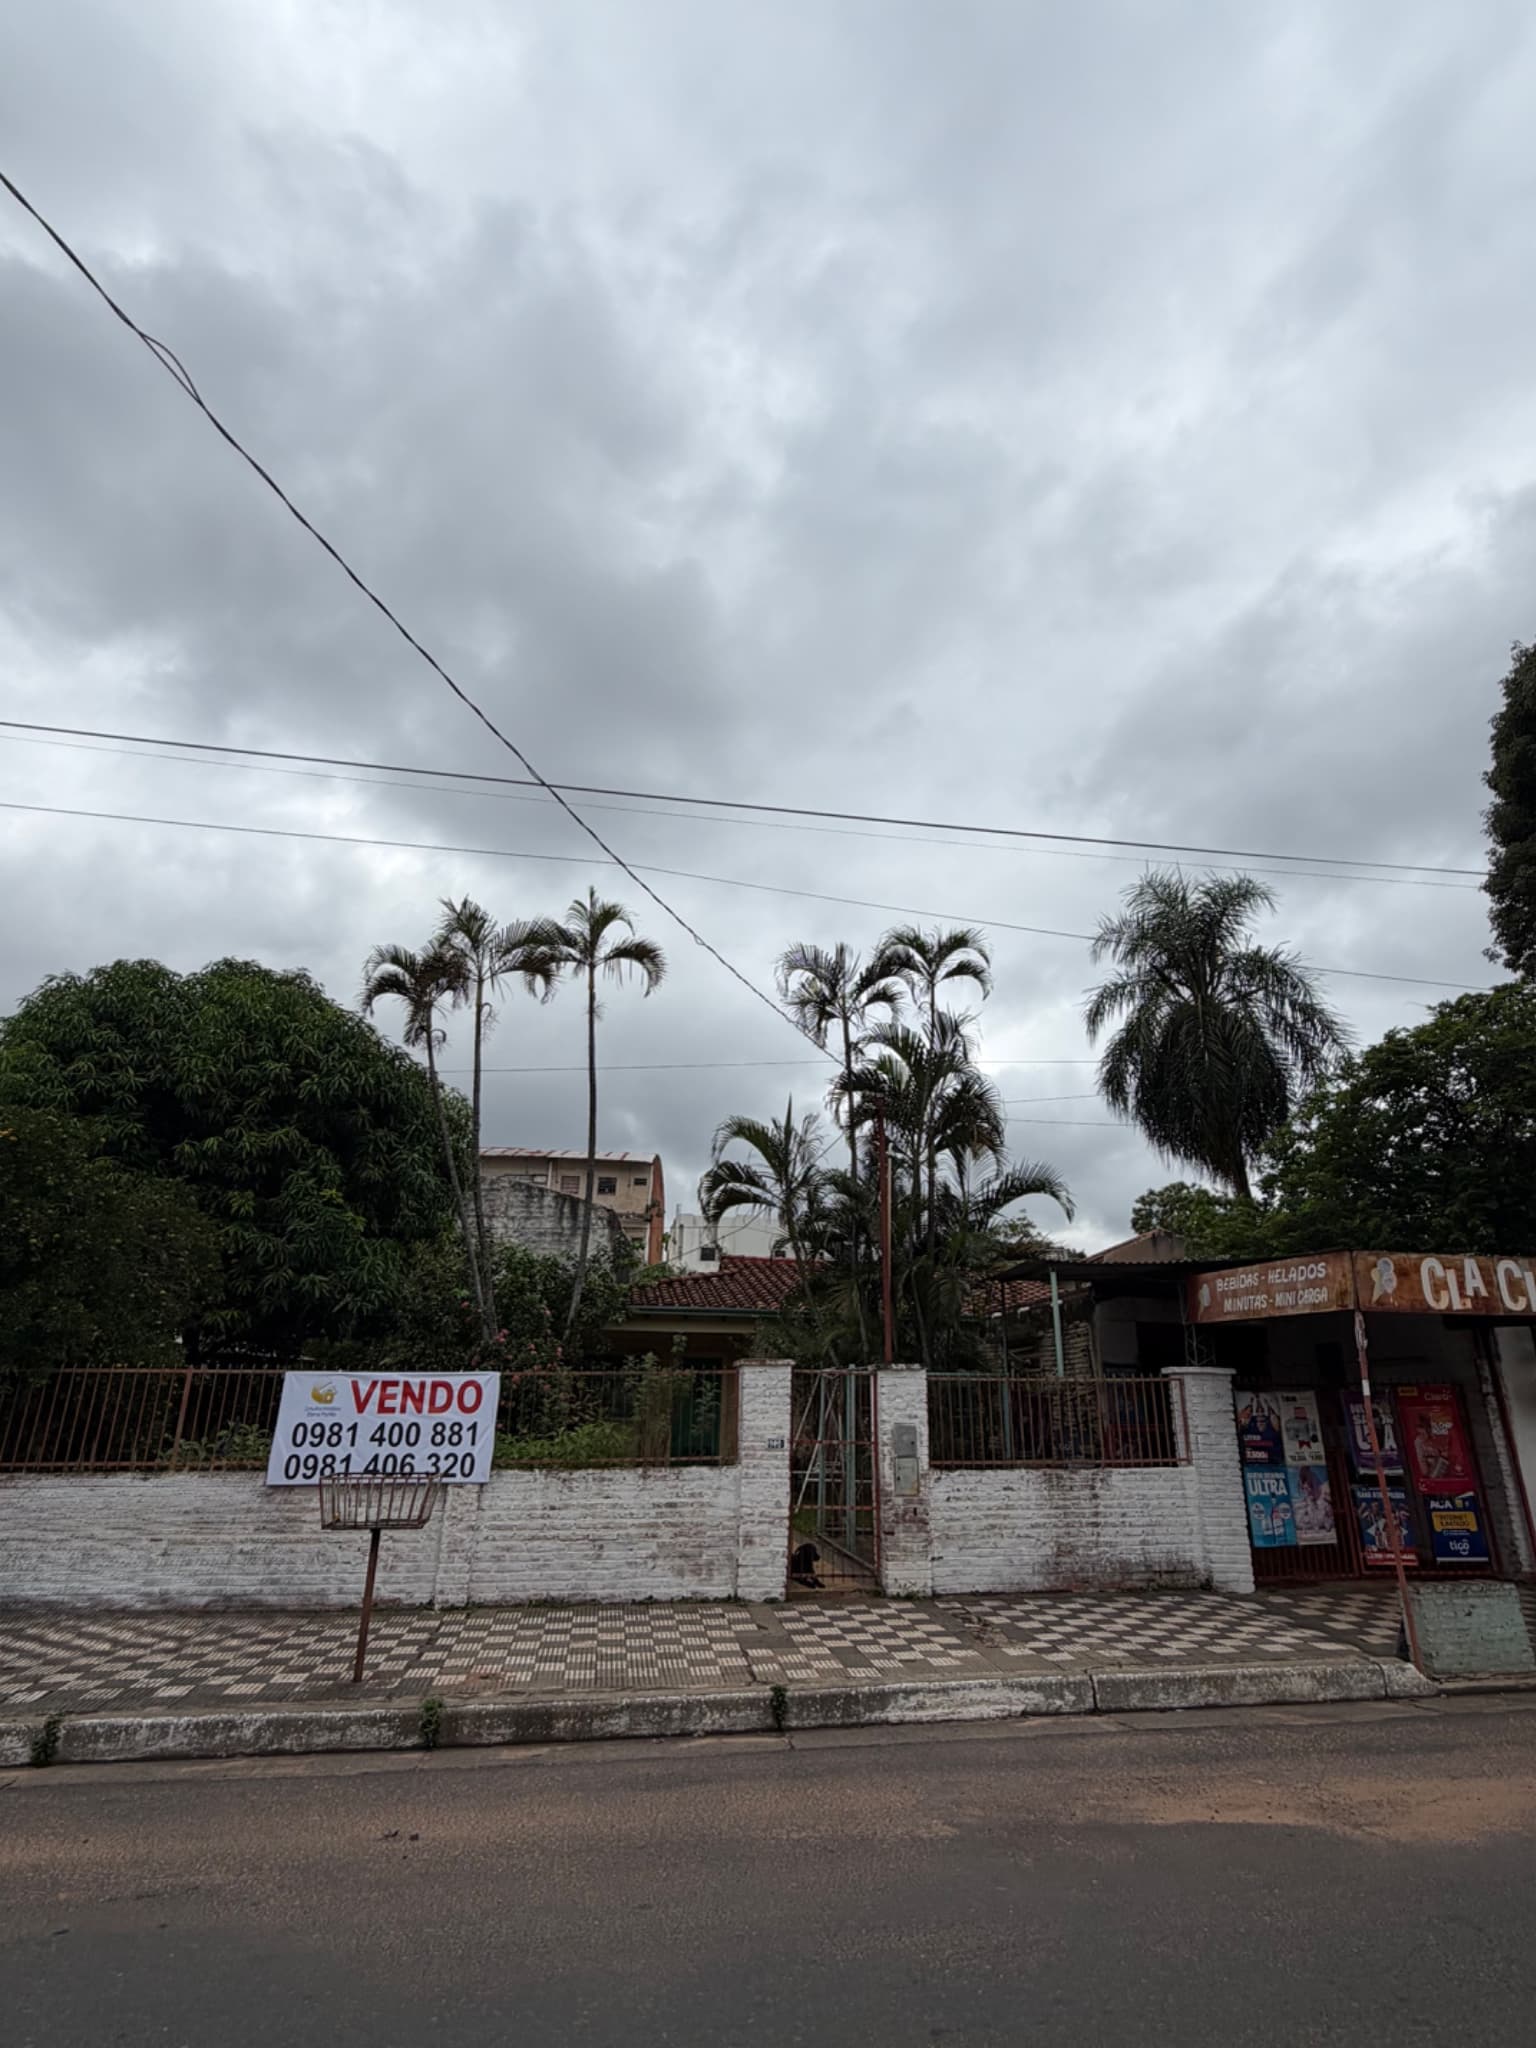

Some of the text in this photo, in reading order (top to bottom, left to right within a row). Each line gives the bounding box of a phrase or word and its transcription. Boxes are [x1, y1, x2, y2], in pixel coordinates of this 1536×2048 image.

[1216, 1272, 1259, 1292] BEBIDAS
[1268, 1262, 1327, 1284] HELADOS
[1223, 1294, 1269, 1313] MINUTAS
[1275, 1290, 1297, 1307] MINI
[1297, 1286, 1328, 1305] CARGA
[351, 1379, 484, 1415] VENDO
[291, 1421, 479, 1448] 0981 400 881
[284, 1452, 476, 1480] 0981 406 320
[1249, 1479, 1289, 1496] ULTRA
[1449, 1539, 1471, 1555] tigo
